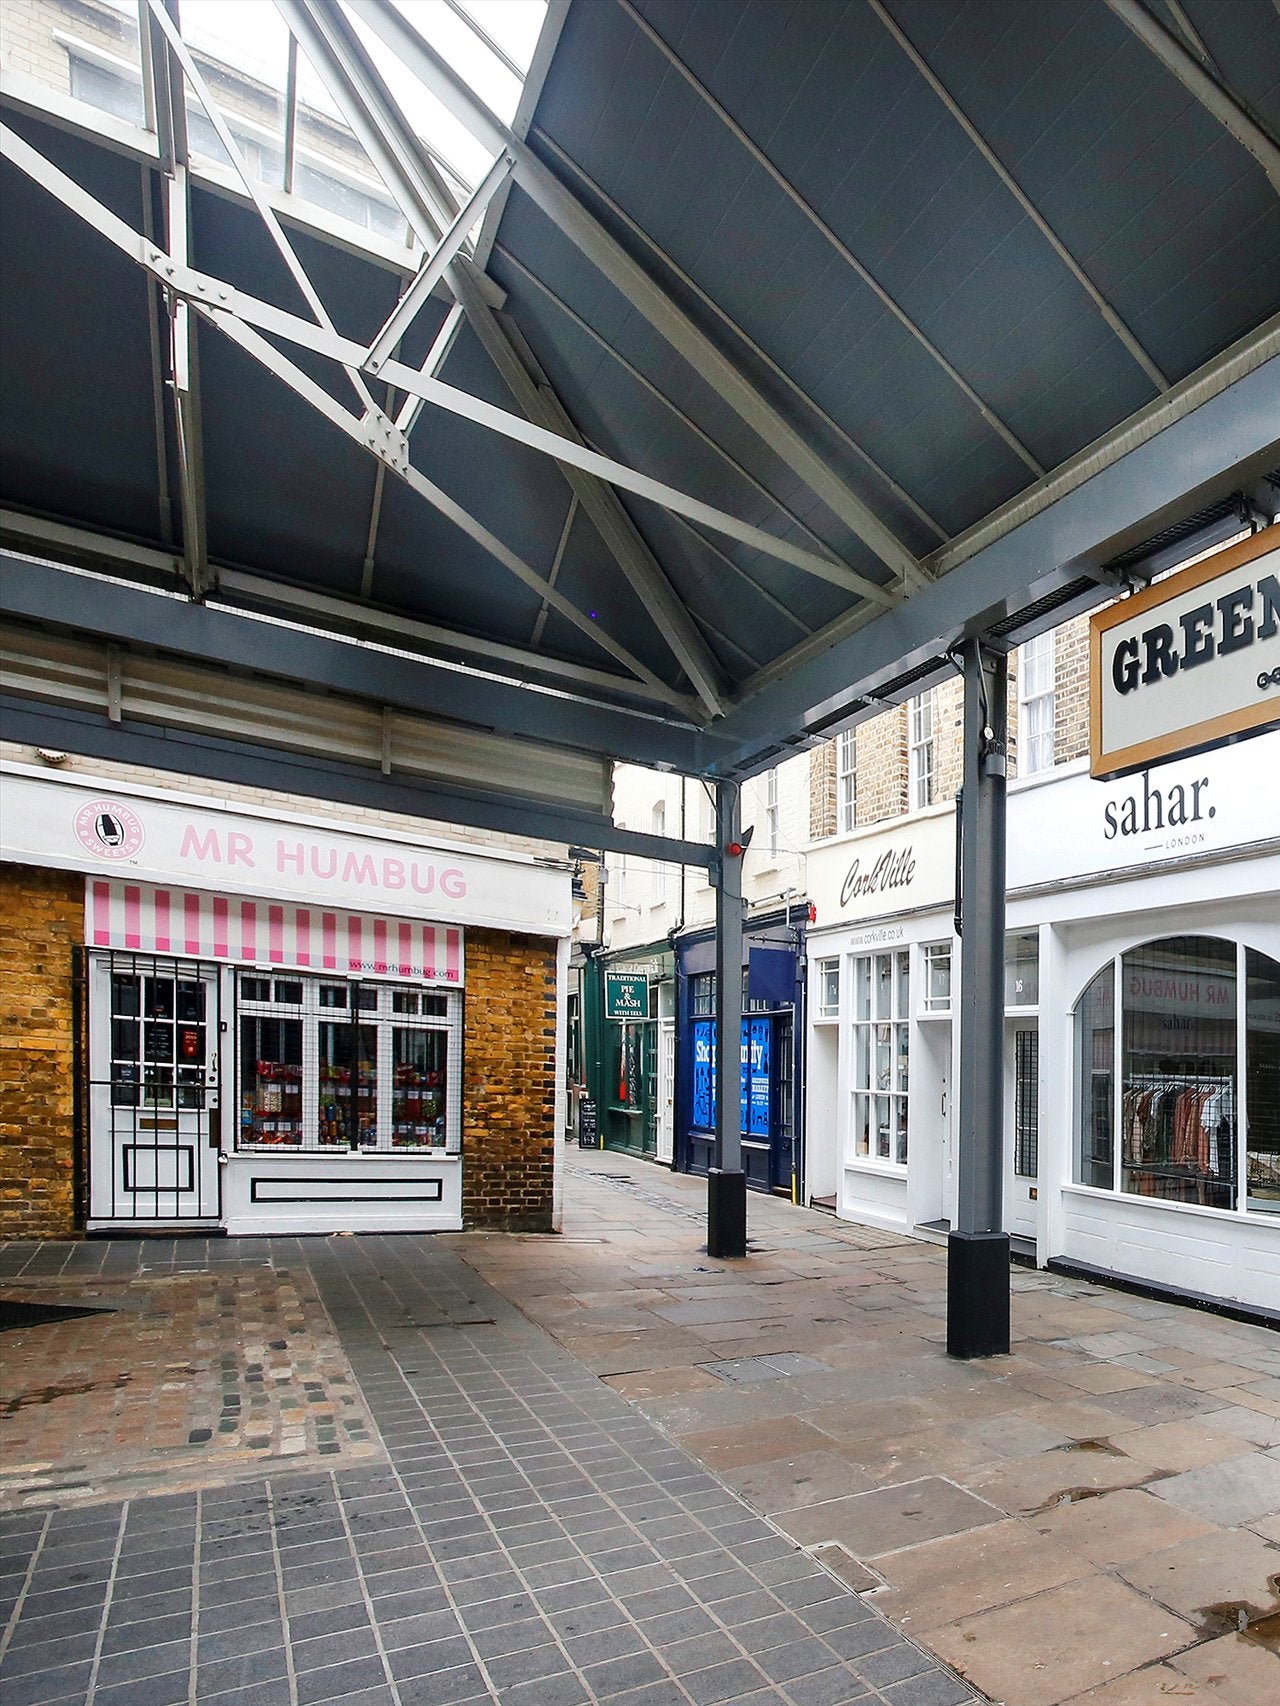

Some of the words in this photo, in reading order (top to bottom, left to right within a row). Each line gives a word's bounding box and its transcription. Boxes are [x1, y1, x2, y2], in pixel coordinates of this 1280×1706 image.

[1103, 769, 1216, 840] sahar.
[1165, 833, 1205, 849] LONDON
[179, 824, 255, 868] MR
[276, 839, 467, 899] HUMBUG
[608, 974, 647, 982] TRADITIONAL
[621, 985, 635, 994] PIE
[615, 999, 641, 1008] MASH
